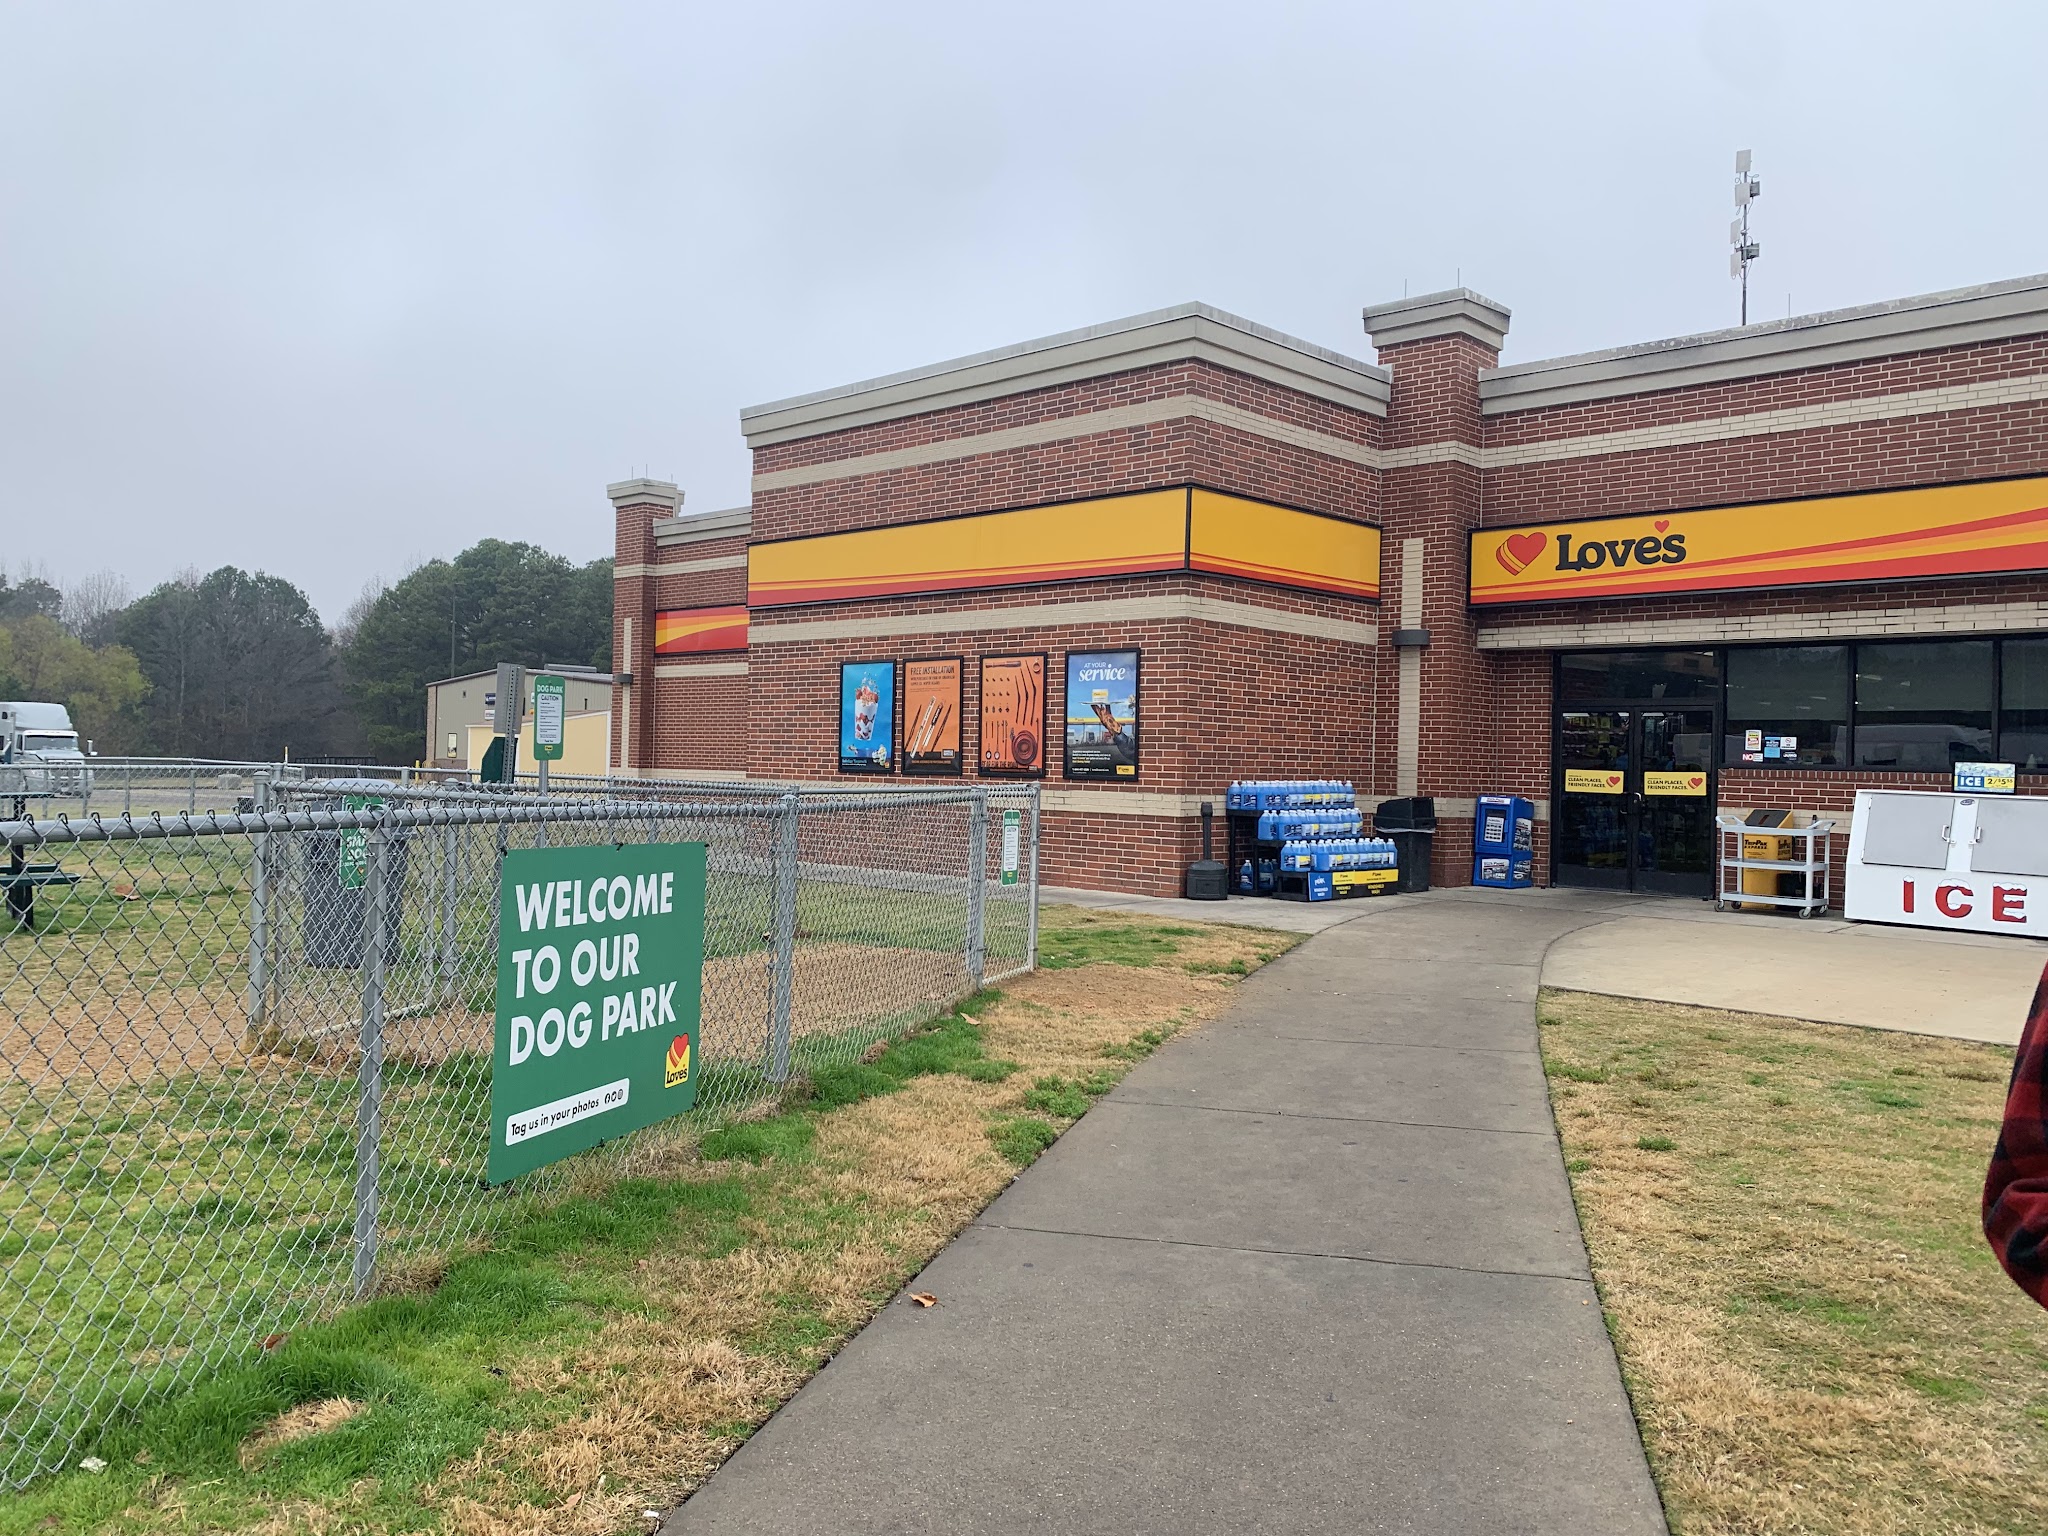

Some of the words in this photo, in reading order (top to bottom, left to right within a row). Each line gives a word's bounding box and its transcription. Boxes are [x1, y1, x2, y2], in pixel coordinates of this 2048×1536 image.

[537, 684, 549, 692] DOG
[911, 667, 922, 675] FREE
[1078, 664, 1126, 681] service
[1960, 776, 1981, 786] ICE
[515, 872, 674, 933] WELCOME
[1903, 876, 2027, 923] ICE
[512, 944, 561, 999] TO
[570, 932, 640, 987] OUR
[509, 1001, 593, 1067] DOG
[601, 980, 678, 1042] PARK
[511, 1123, 526, 1137] Tag
[528, 1118, 539, 1130] us
[540, 1113, 549, 1127] in
[550, 1108, 570, 1127] your
[572, 1097, 600, 1119] photos
